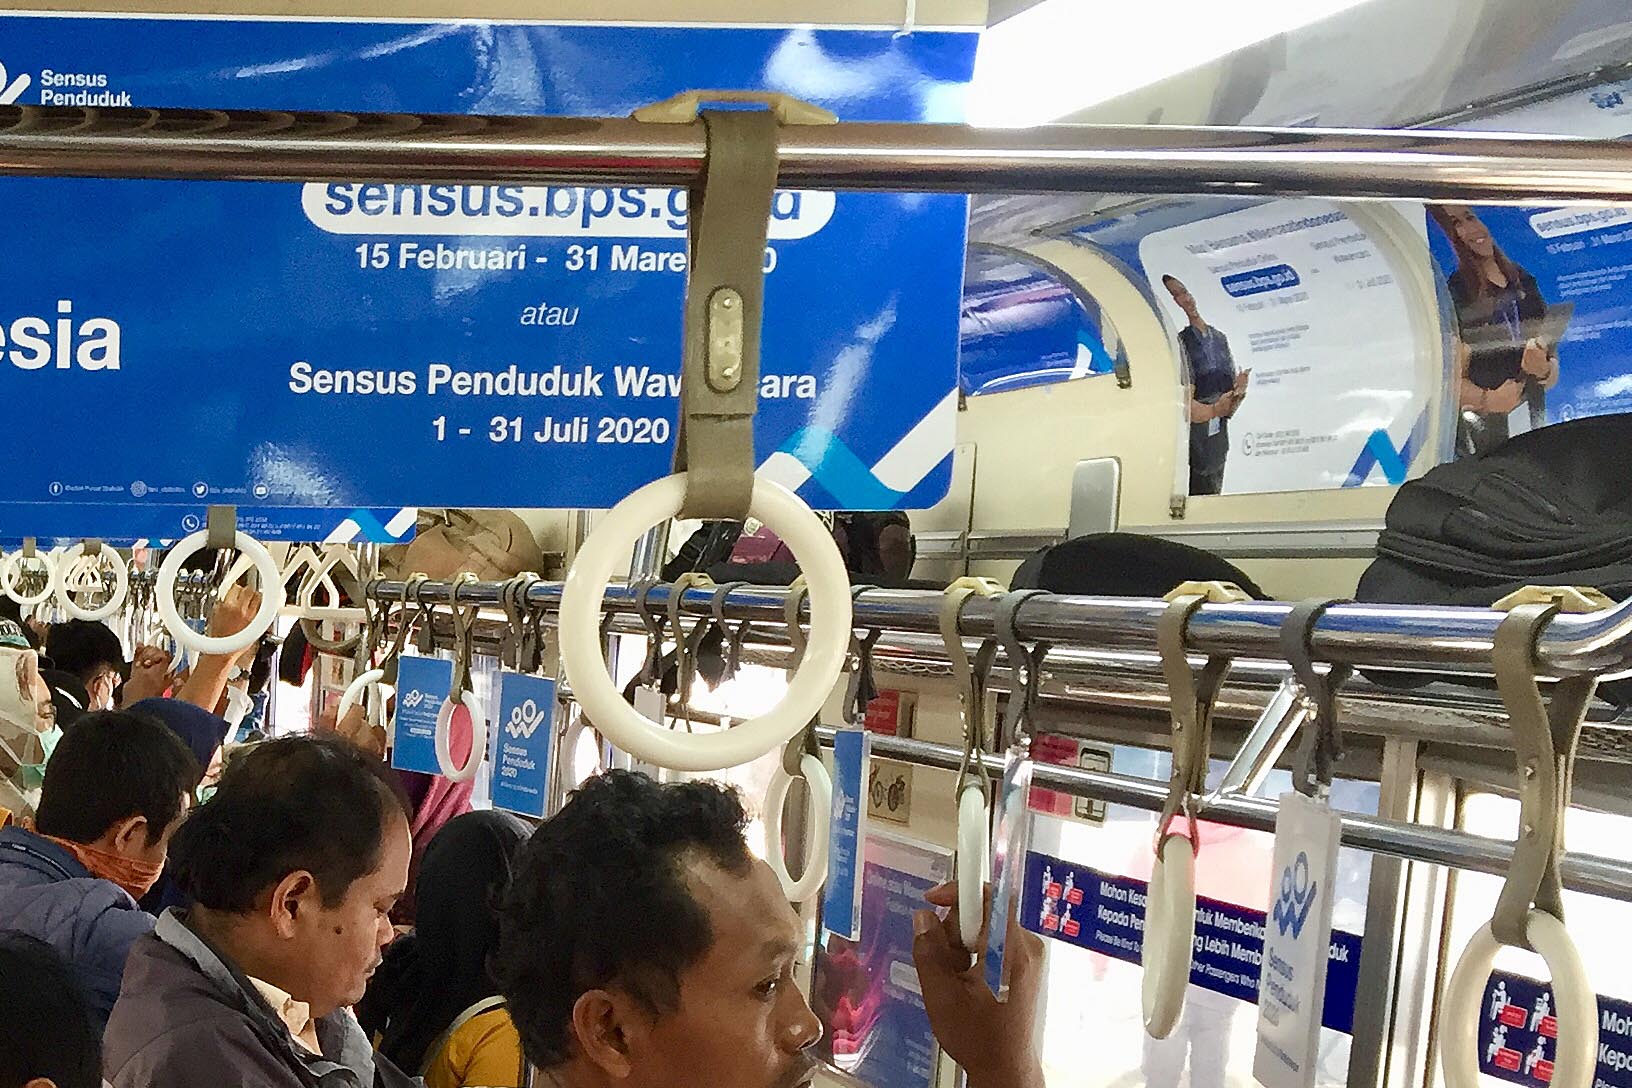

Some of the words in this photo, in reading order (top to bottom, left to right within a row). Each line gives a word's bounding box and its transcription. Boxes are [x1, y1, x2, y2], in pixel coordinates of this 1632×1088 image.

[40, 69, 107, 87] Sensus
[41, 90, 132, 106] Penduduk
[325, 184, 801, 230] sensus.bps.gd
[356, 243, 389, 269] 15
[399, 243, 526, 270] Februari
[565, 245, 598, 271] 31
[611, 245, 687, 272] Mare
[520, 302, 579, 326] atau
[289, 361, 416, 395] Sensus
[428, 363, 603, 396] Penduduk
[432, 416, 446, 440] 1
[489, 416, 522, 442] 31
[534, 416, 588, 443] Juli
[596, 418, 669, 444] 2020
[1098, 904, 1128, 929] Kepada
[1204, 936, 1230, 957] Lebih
[1100, 881, 1128, 902] Mohon
[1329, 942, 1349, 962] duk
[1602, 1010, 1632, 1036] Moh
